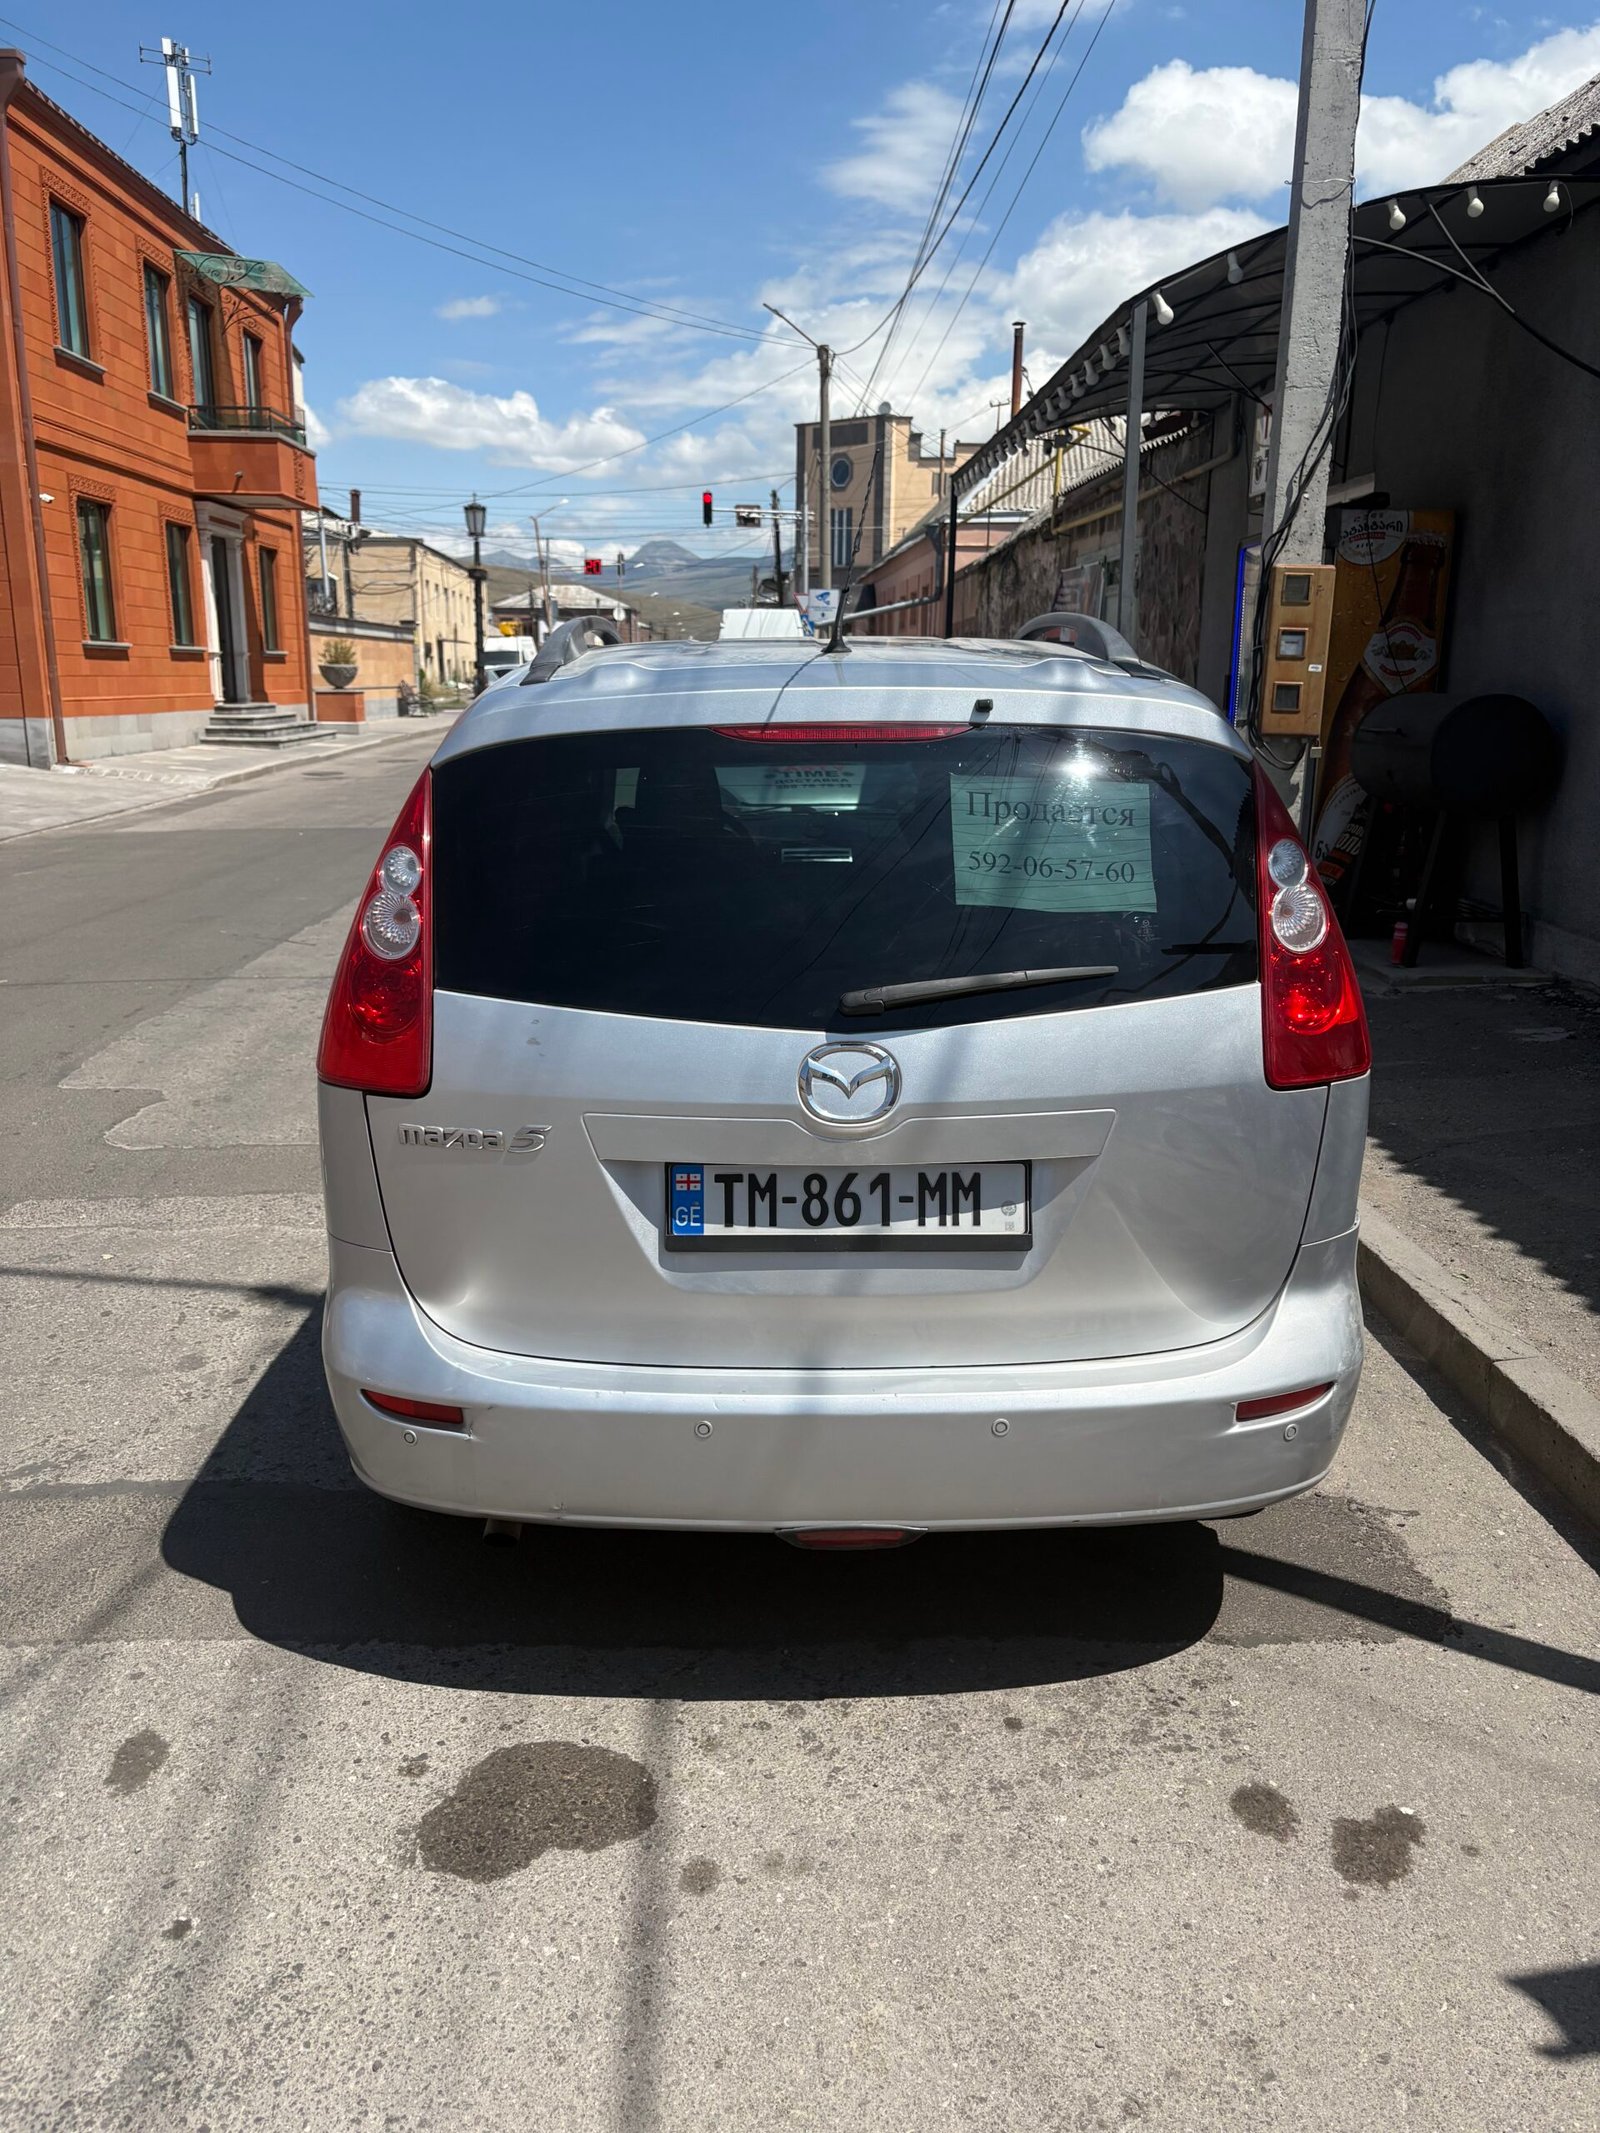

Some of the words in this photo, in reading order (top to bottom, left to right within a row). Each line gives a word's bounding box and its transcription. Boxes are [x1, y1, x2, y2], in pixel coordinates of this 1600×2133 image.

[1338, 520, 1404, 541] ატახტარი
[584, 560, 601, 575] 20
[783, 770, 840, 778] TIME
[966, 791, 1136, 827] Продается
[968, 850, 1135, 884] 592-06-57-60
[508, 1125, 552, 1152] 5
[714, 1172, 981, 1228] TM-861-MM
[675, 1206, 701, 1227] GE
